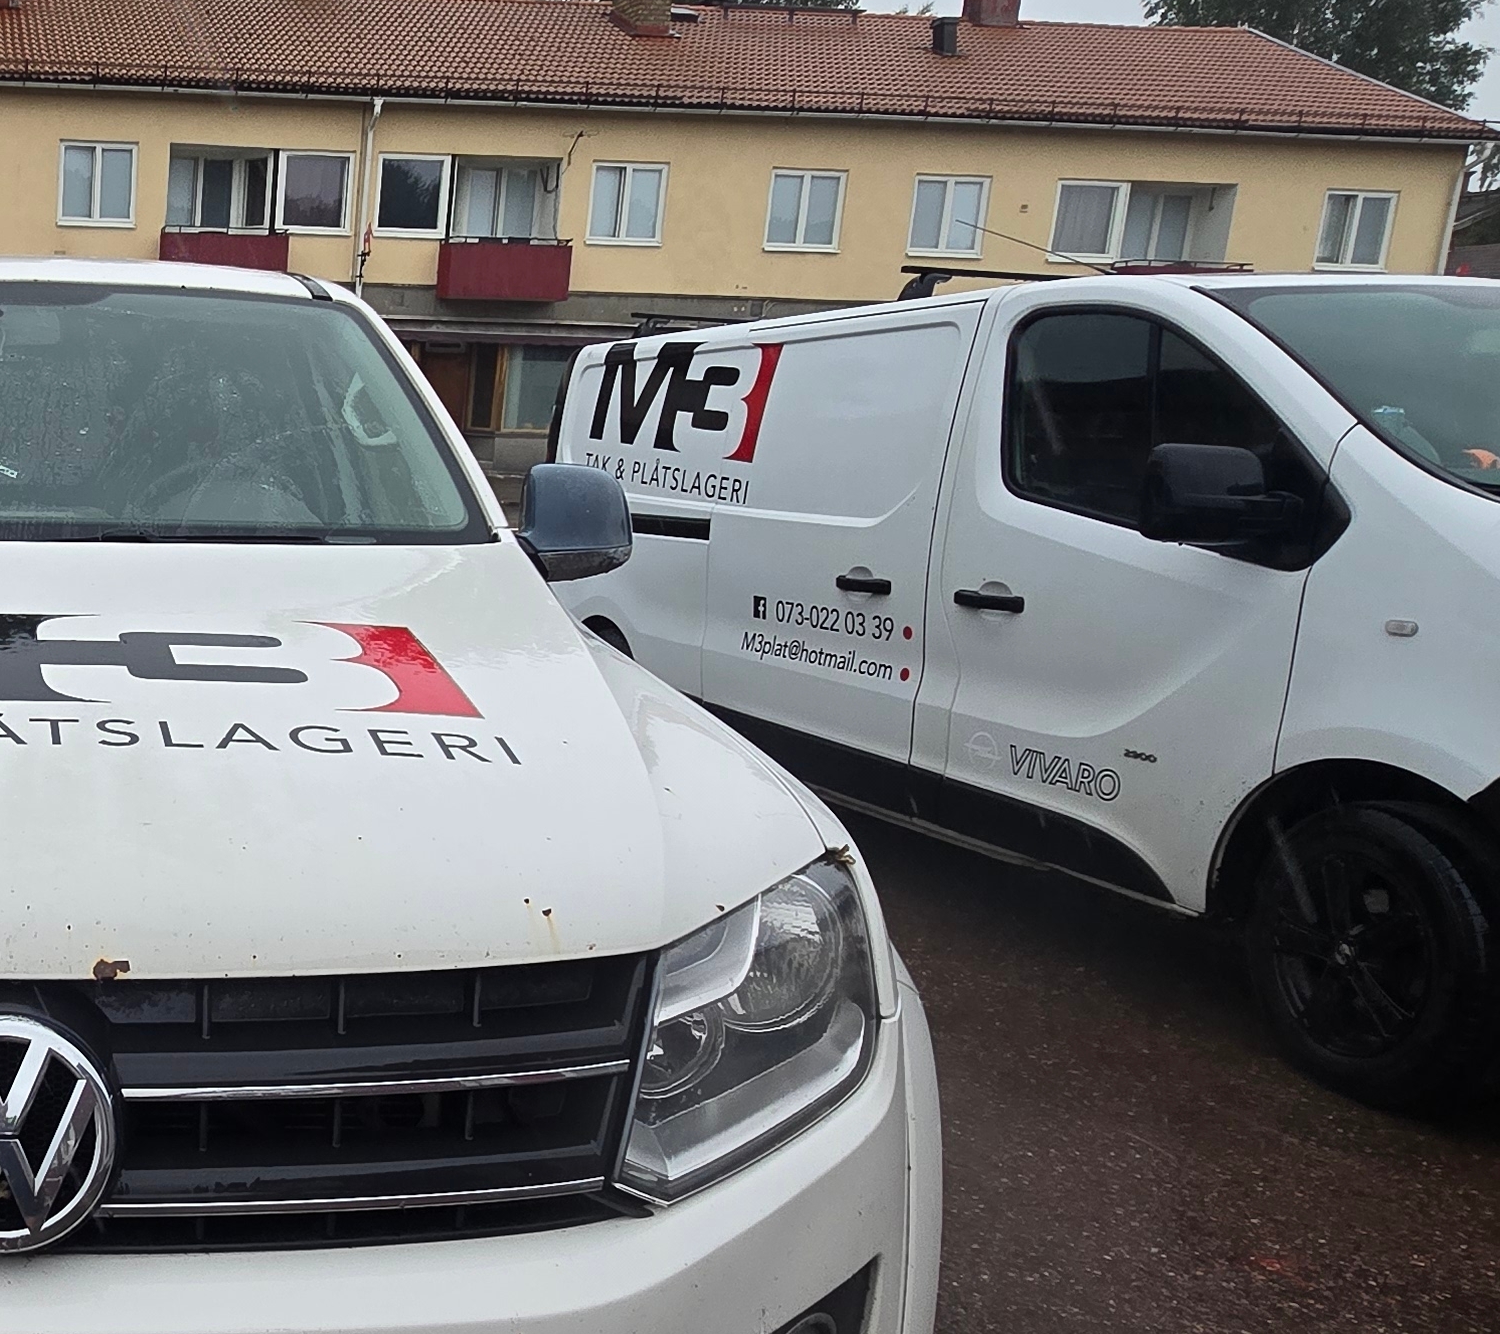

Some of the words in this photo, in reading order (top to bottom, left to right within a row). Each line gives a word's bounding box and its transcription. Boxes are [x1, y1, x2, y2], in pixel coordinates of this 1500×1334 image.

[589, 342, 785, 463] M3
[615, 458, 626, 480] &
[631, 458, 750, 505] PLÅTSLAGERI
[775, 600, 840, 634] 073-022
[844, 613, 866, 637] 03
[871, 616, 894, 641] 39
[740, 631, 893, 681] M3plat@hotmail.com
[1008, 744, 1122, 802] VIVARO
